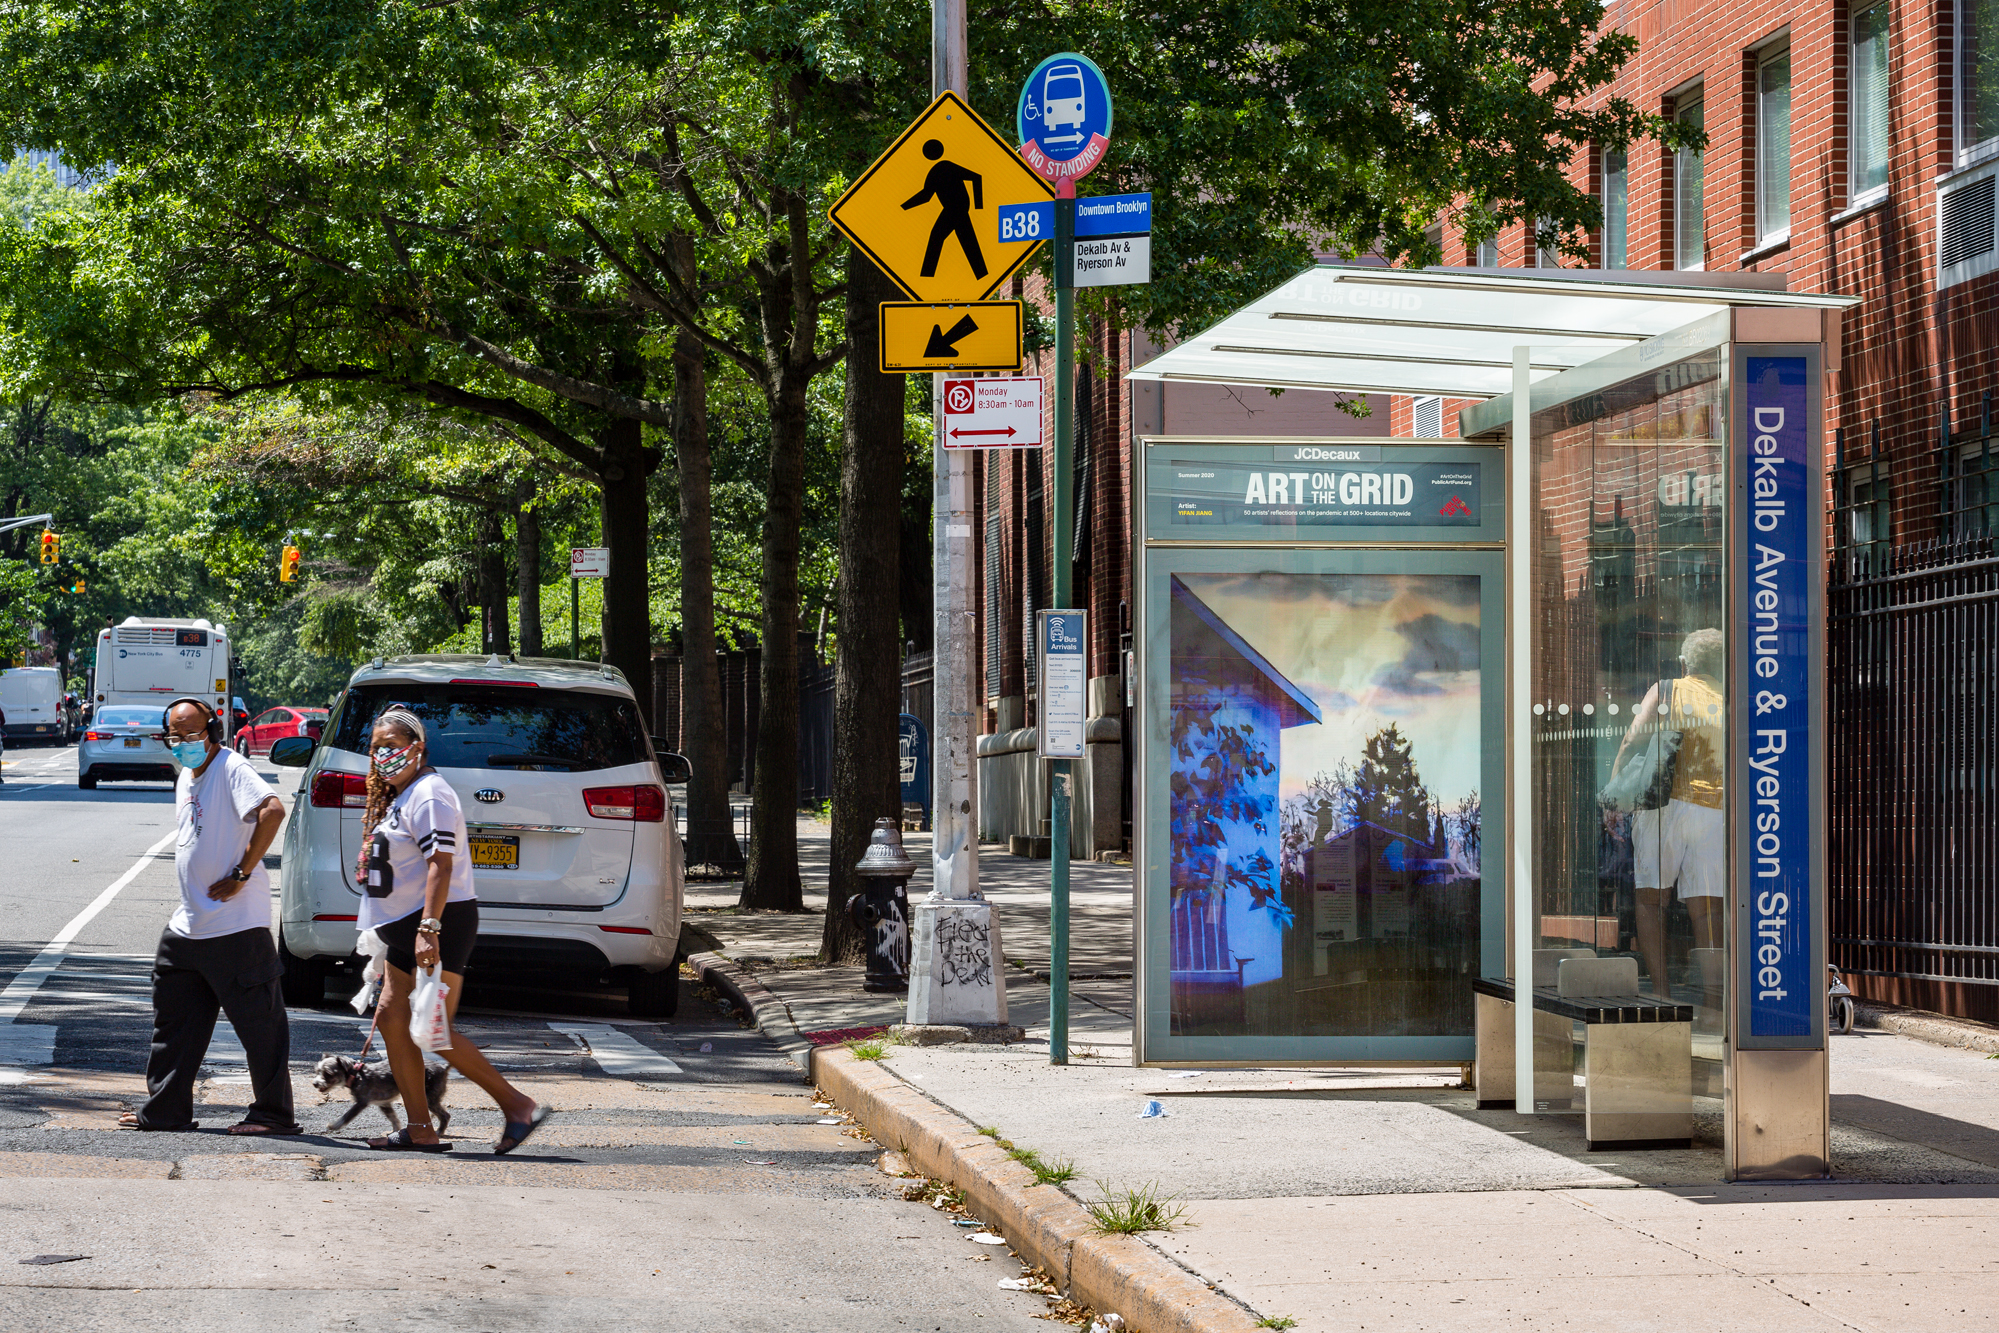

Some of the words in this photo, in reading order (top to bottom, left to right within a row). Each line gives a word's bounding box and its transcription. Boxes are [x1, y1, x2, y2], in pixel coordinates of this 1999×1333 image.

[1028, 148, 1044, 168] NO
[1046, 142, 1100, 176] STANDING
[1078, 204, 1115, 217] Downtown
[1116, 200, 1148, 214] Brooklyn
[1002, 211, 1040, 239] B38
[1078, 243, 1108, 256] Dekalb
[1110, 242, 1121, 253] Av
[1124, 241, 1131, 252] &
[1078, 258, 1112, 272] Ryerson
[1115, 256, 1126, 267] Av
[978, 387, 1008, 396] Monday
[978, 400, 1007, 408] 8:30am
[1294, 448, 1360, 460] JCDecaux
[1753, 407, 1786, 532] Dekalb
[1245, 472, 1309, 504] ART
[1339, 472, 1414, 505] GRID
[1312, 473, 1335, 489] ON
[1311, 491, 1335, 504] THE
[1439, 495, 1459, 516] PUBLIC
[1448, 504, 1460, 517] ART
[1754, 543, 1787, 679] Avenue
[180, 649, 201, 658] 4775
[1756, 692, 1788, 716] &
[479, 791, 500, 800] KIA
[1749, 729, 1788, 878] Ryerson
[487, 845, 512, 861] 9355
[1757, 891, 1789, 1000] Street
